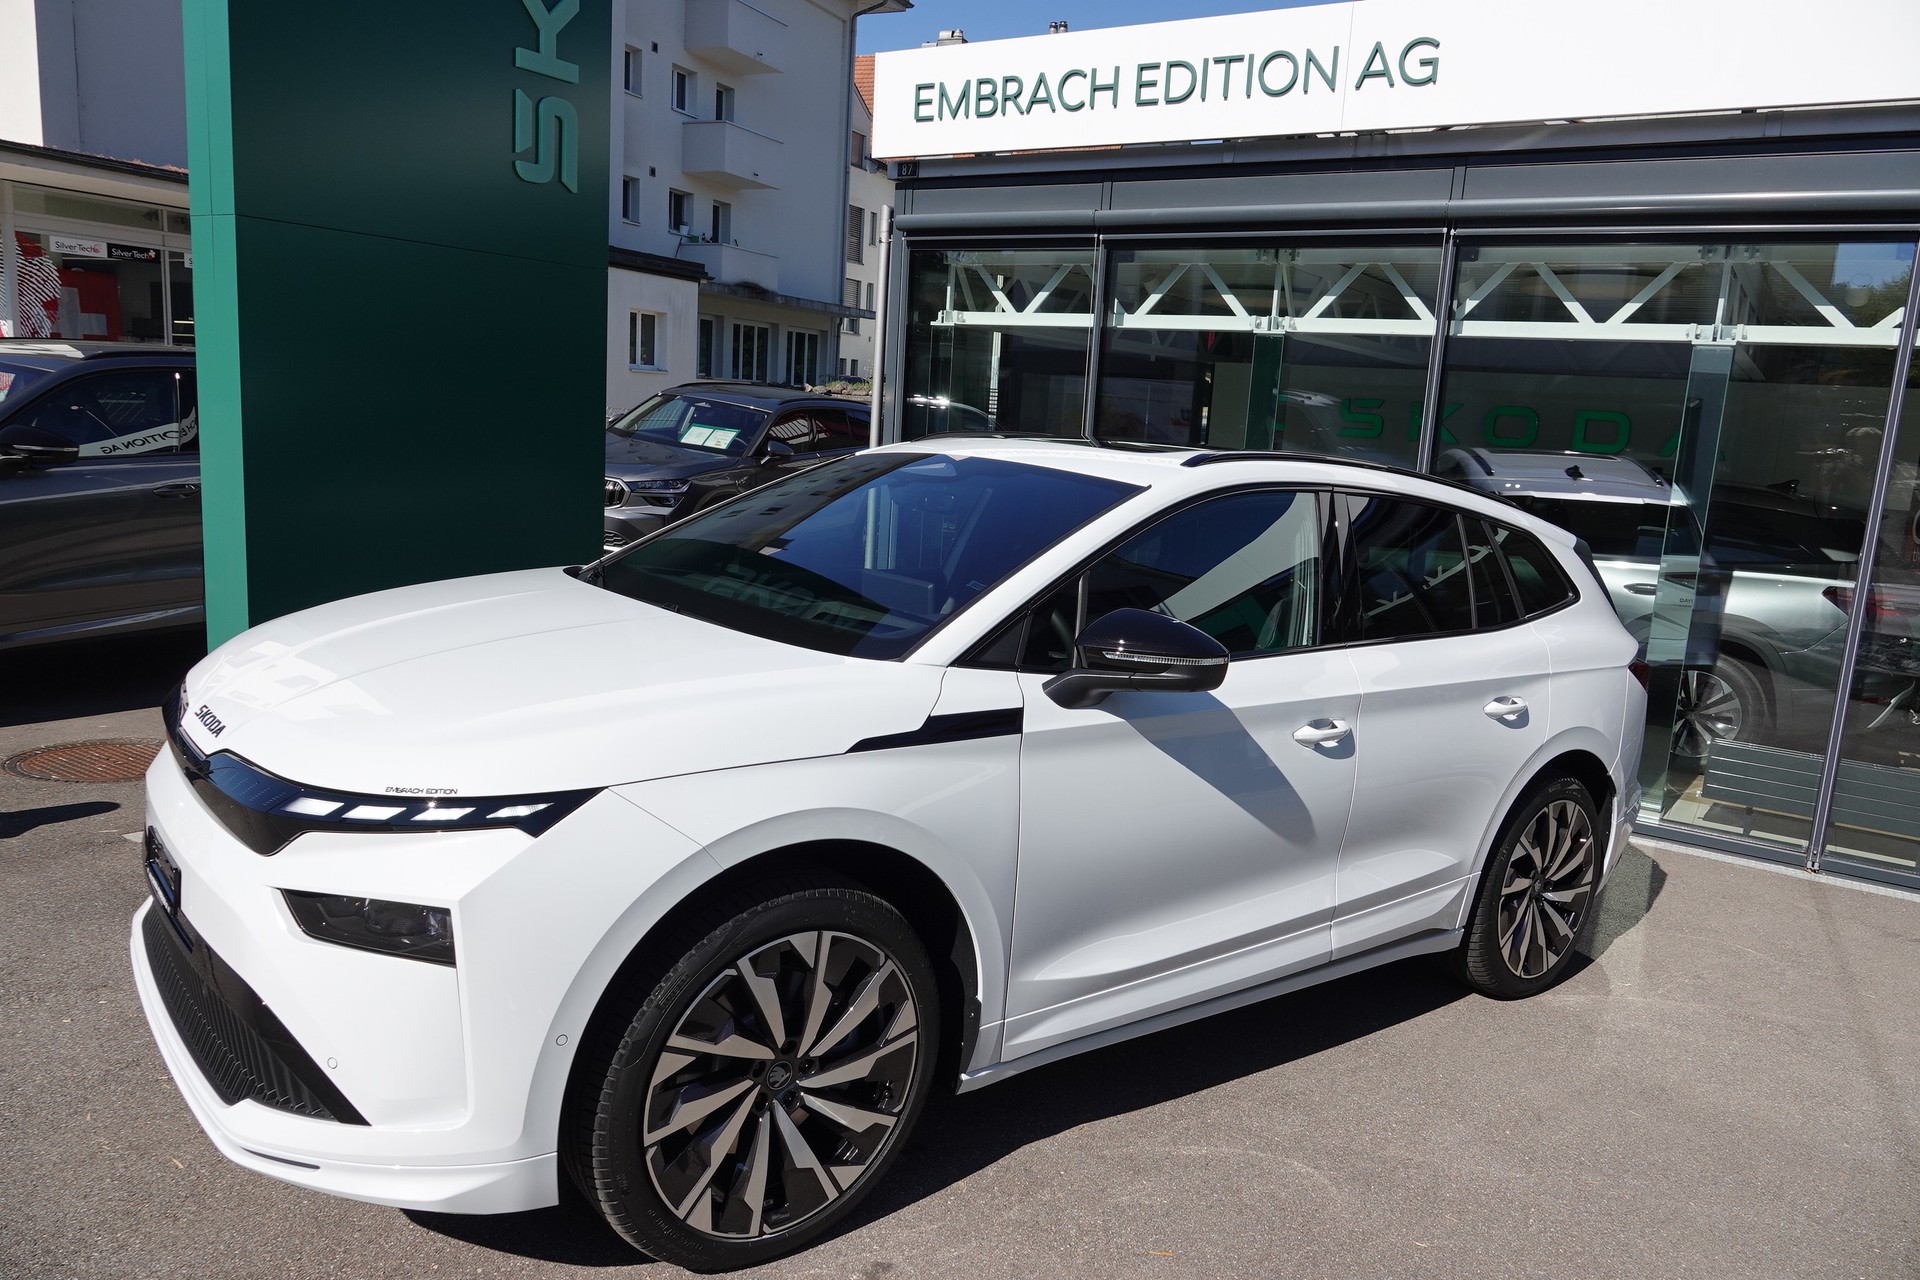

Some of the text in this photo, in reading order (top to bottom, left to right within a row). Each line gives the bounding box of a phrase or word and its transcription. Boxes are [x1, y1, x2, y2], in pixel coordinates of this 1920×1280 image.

[914, 36, 1441, 122] EMBRACH EDITION AG
[901, 163, 913, 176] 87
[194, 704, 226, 738] SKODA
[385, 786, 458, 795] EMBRACH EDITION
